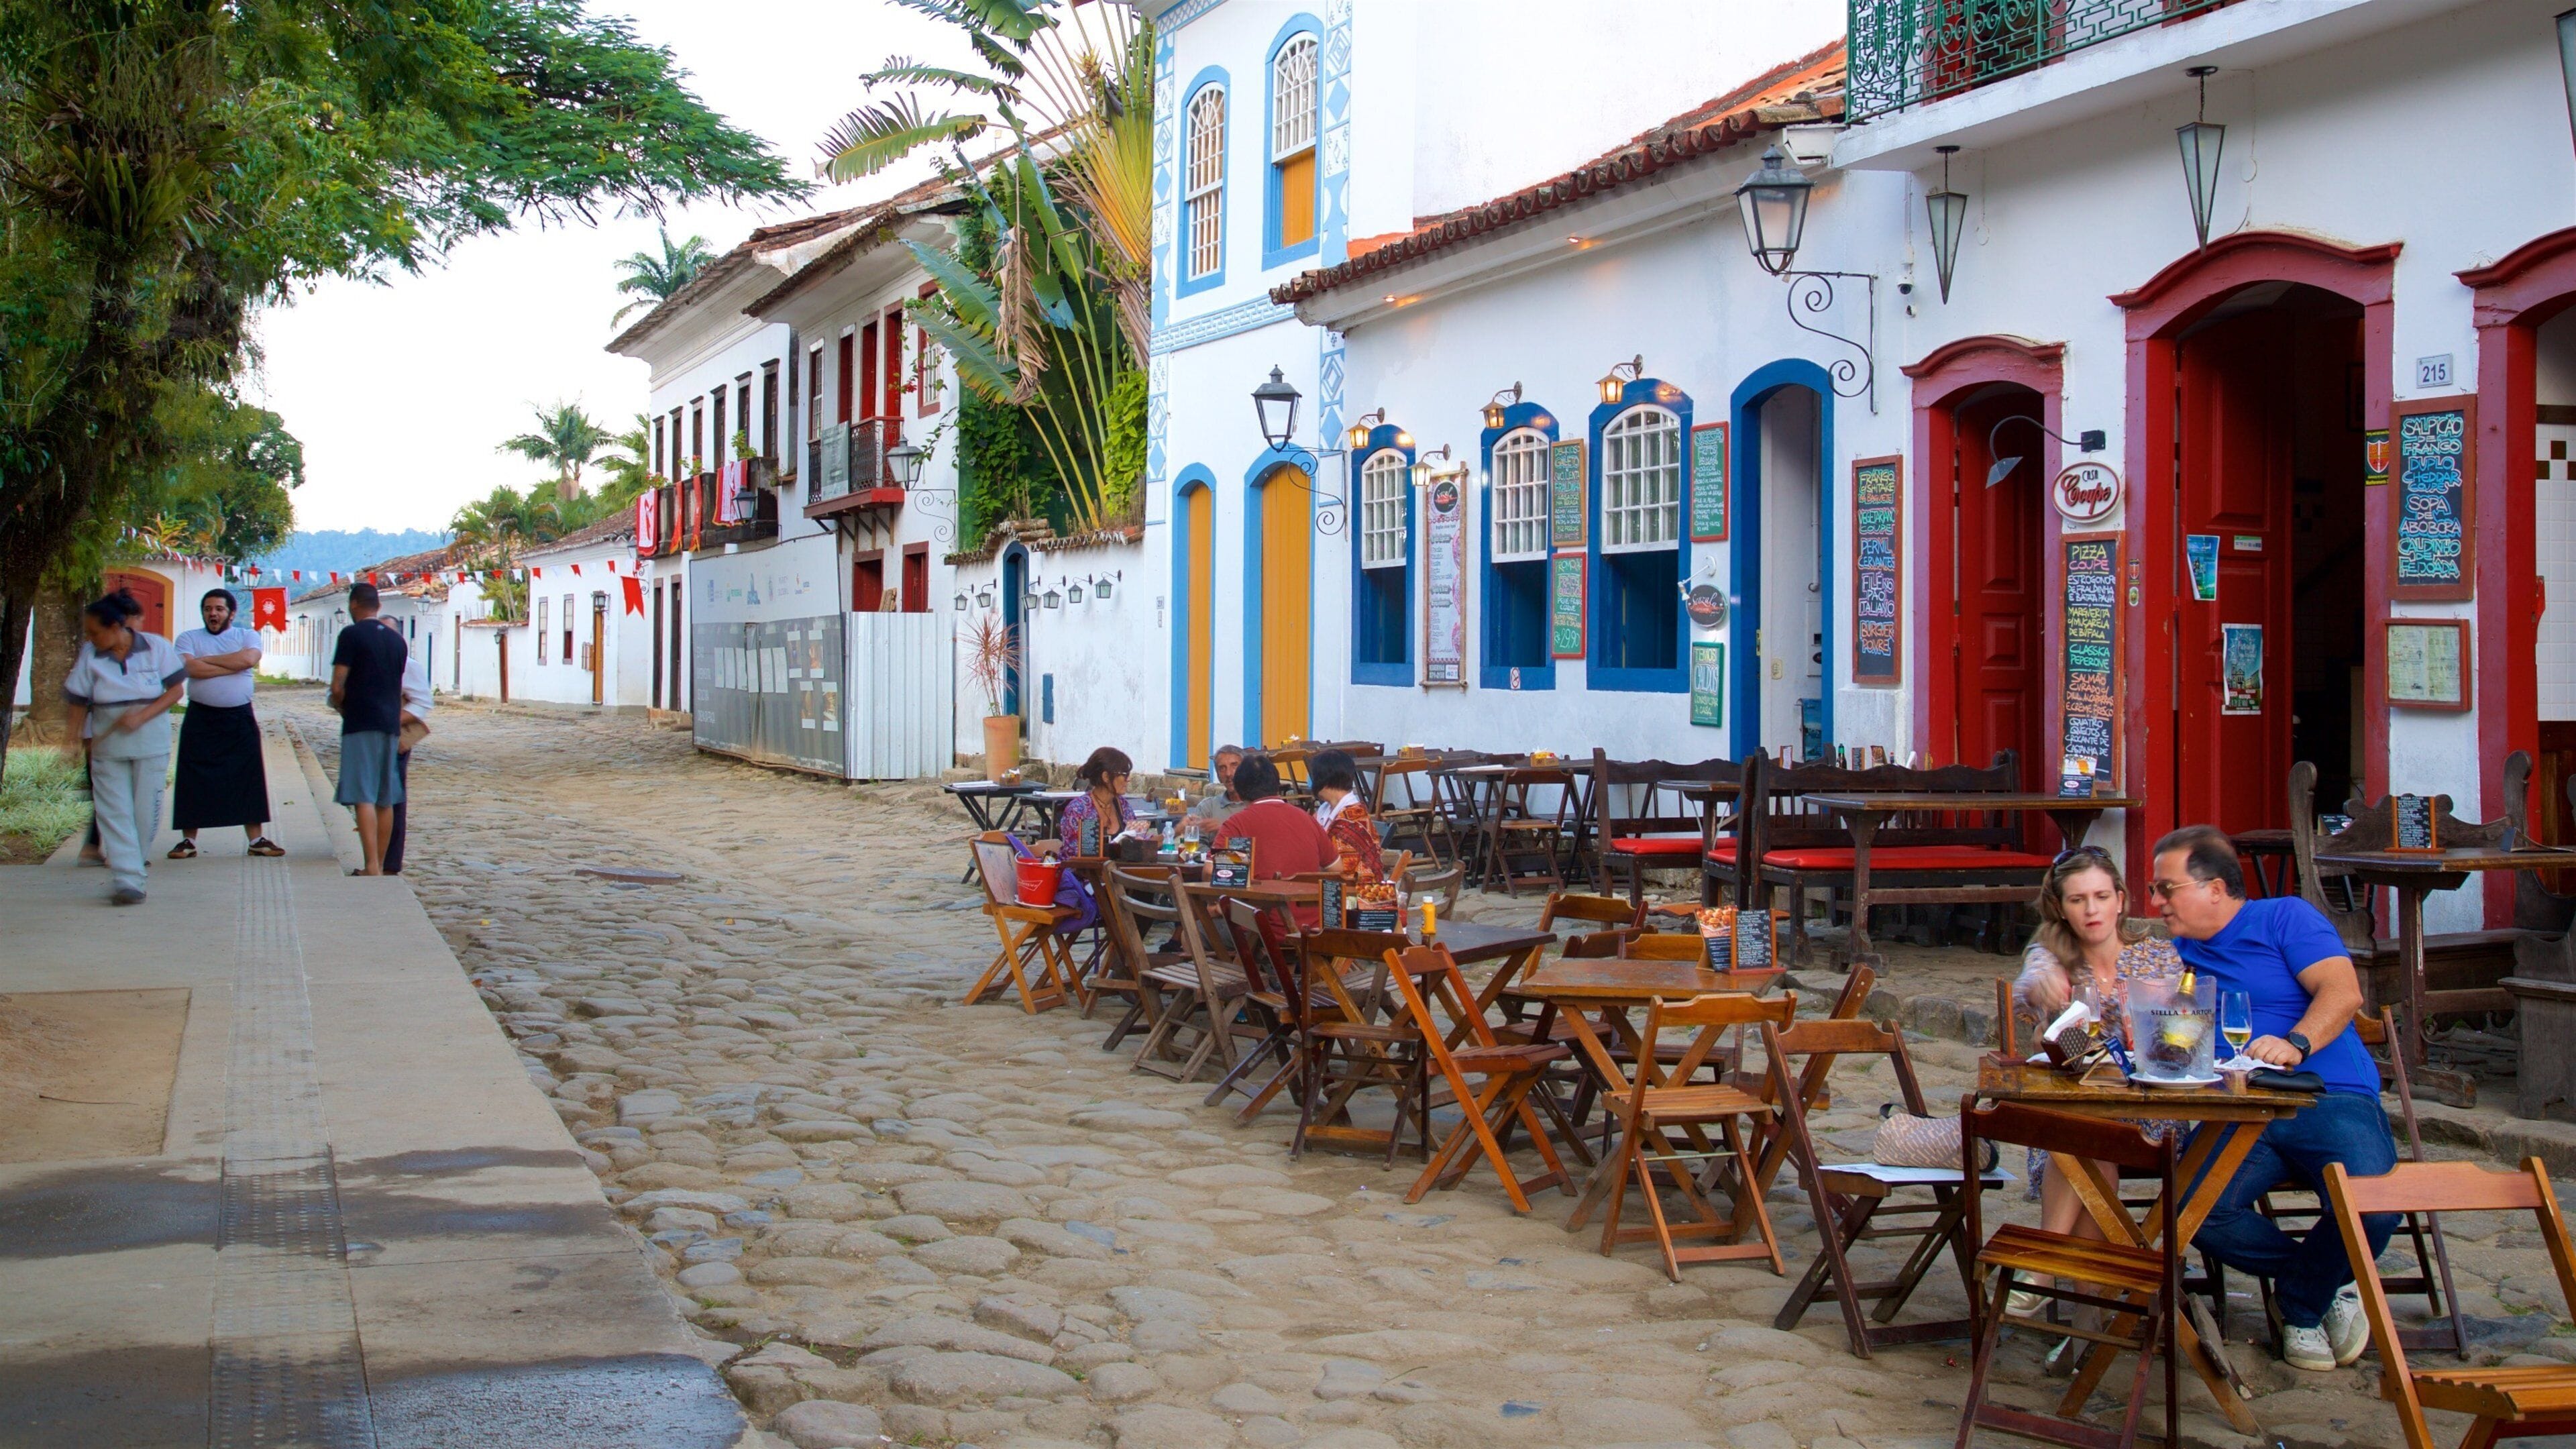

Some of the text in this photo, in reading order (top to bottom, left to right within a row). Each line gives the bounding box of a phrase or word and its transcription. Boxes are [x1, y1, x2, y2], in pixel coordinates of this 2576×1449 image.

[2422, 364, 2446, 383] 215
[2402, 415, 2463, 436] SALPICÃO
[2404, 441, 2461, 453] FRANGO
[2409, 457, 2454, 470] DUPLO
[1860, 472, 1895, 483] FRANGO
[2082, 470, 2098, 482] CASA
[2402, 471, 2460, 484] CHEDDAR
[2408, 496, 2448, 512] SOPA
[2417, 512, 2433, 520] DE
[1860, 524, 1892, 532] COUPE
[2400, 521, 2461, 534] ABOBORA
[1861, 539, 1891, 555] PERNIL
[2071, 544, 2107, 559] PIZZA
[2400, 539, 2461, 553] CALDINHO
[1859, 556, 1894, 568] CERVANTES
[2416, 552, 2432, 560] DE
[2069, 559, 2110, 571] COUPE
[2401, 560, 2459, 575] FEIJOADA
[1862, 573, 1882, 590] FILÉ
[1868, 590, 1885, 601] PÃO
[2076, 585, 2114, 594] FRALDINHA
[2069, 593, 2074, 601] E
[2076, 593, 2097, 602] BATATA
[1860, 600, 1895, 615] ITALIANO
[2070, 628, 2078, 637] DE
[2070, 654, 2110, 669] PEPERONE
[2071, 672, 2107, 686] SALMÃO
[2070, 683, 2100, 695] CURADO
[2066, 702, 2071, 710] E
[2070, 717, 2104, 728] QUATRO
[2070, 726, 2110, 738] QUEIJOS E
[2065, 735, 2110, 747] CROCANTE DE
[2065, 744, 2108, 756] CASTANHA DE
